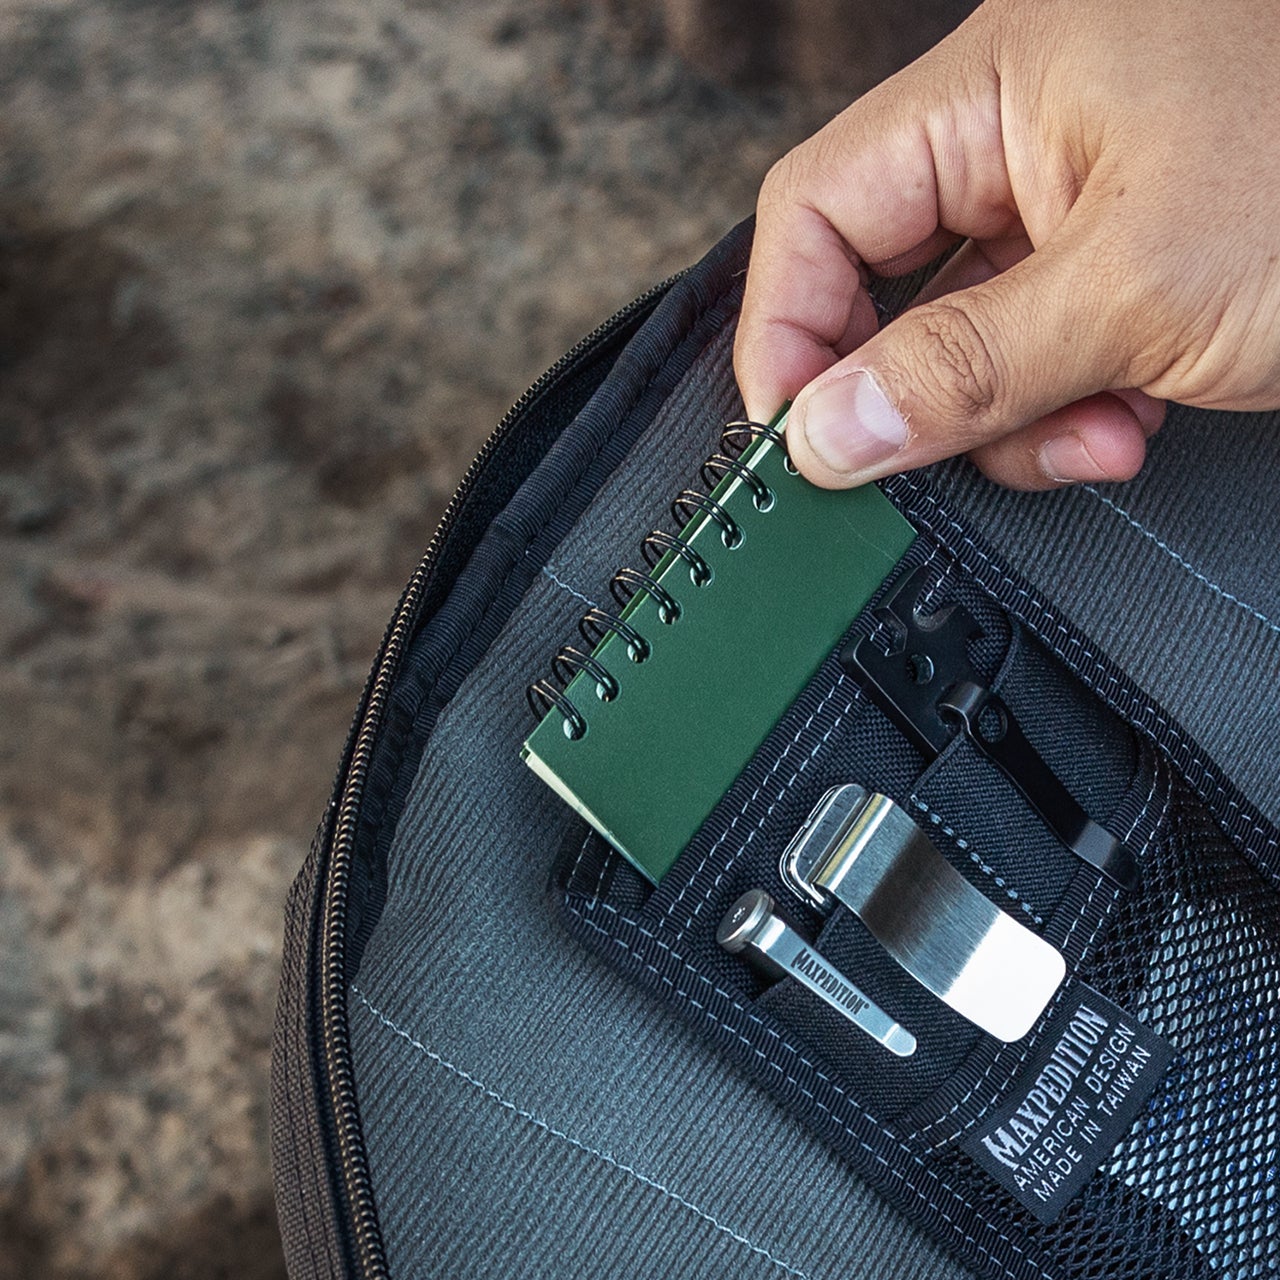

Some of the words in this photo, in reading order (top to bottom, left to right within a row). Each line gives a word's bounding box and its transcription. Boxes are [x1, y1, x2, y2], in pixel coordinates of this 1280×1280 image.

[981, 1003, 1109, 1171] MAXPEDITION
[1013, 1095, 1090, 1191] AMERICAN
[1084, 1022, 1136, 1094] DESIGN
[1033, 1145, 1083, 1202] MADE
[1079, 1119, 1102, 1144] IN
[1097, 1045, 1152, 1116] TAIWAN
